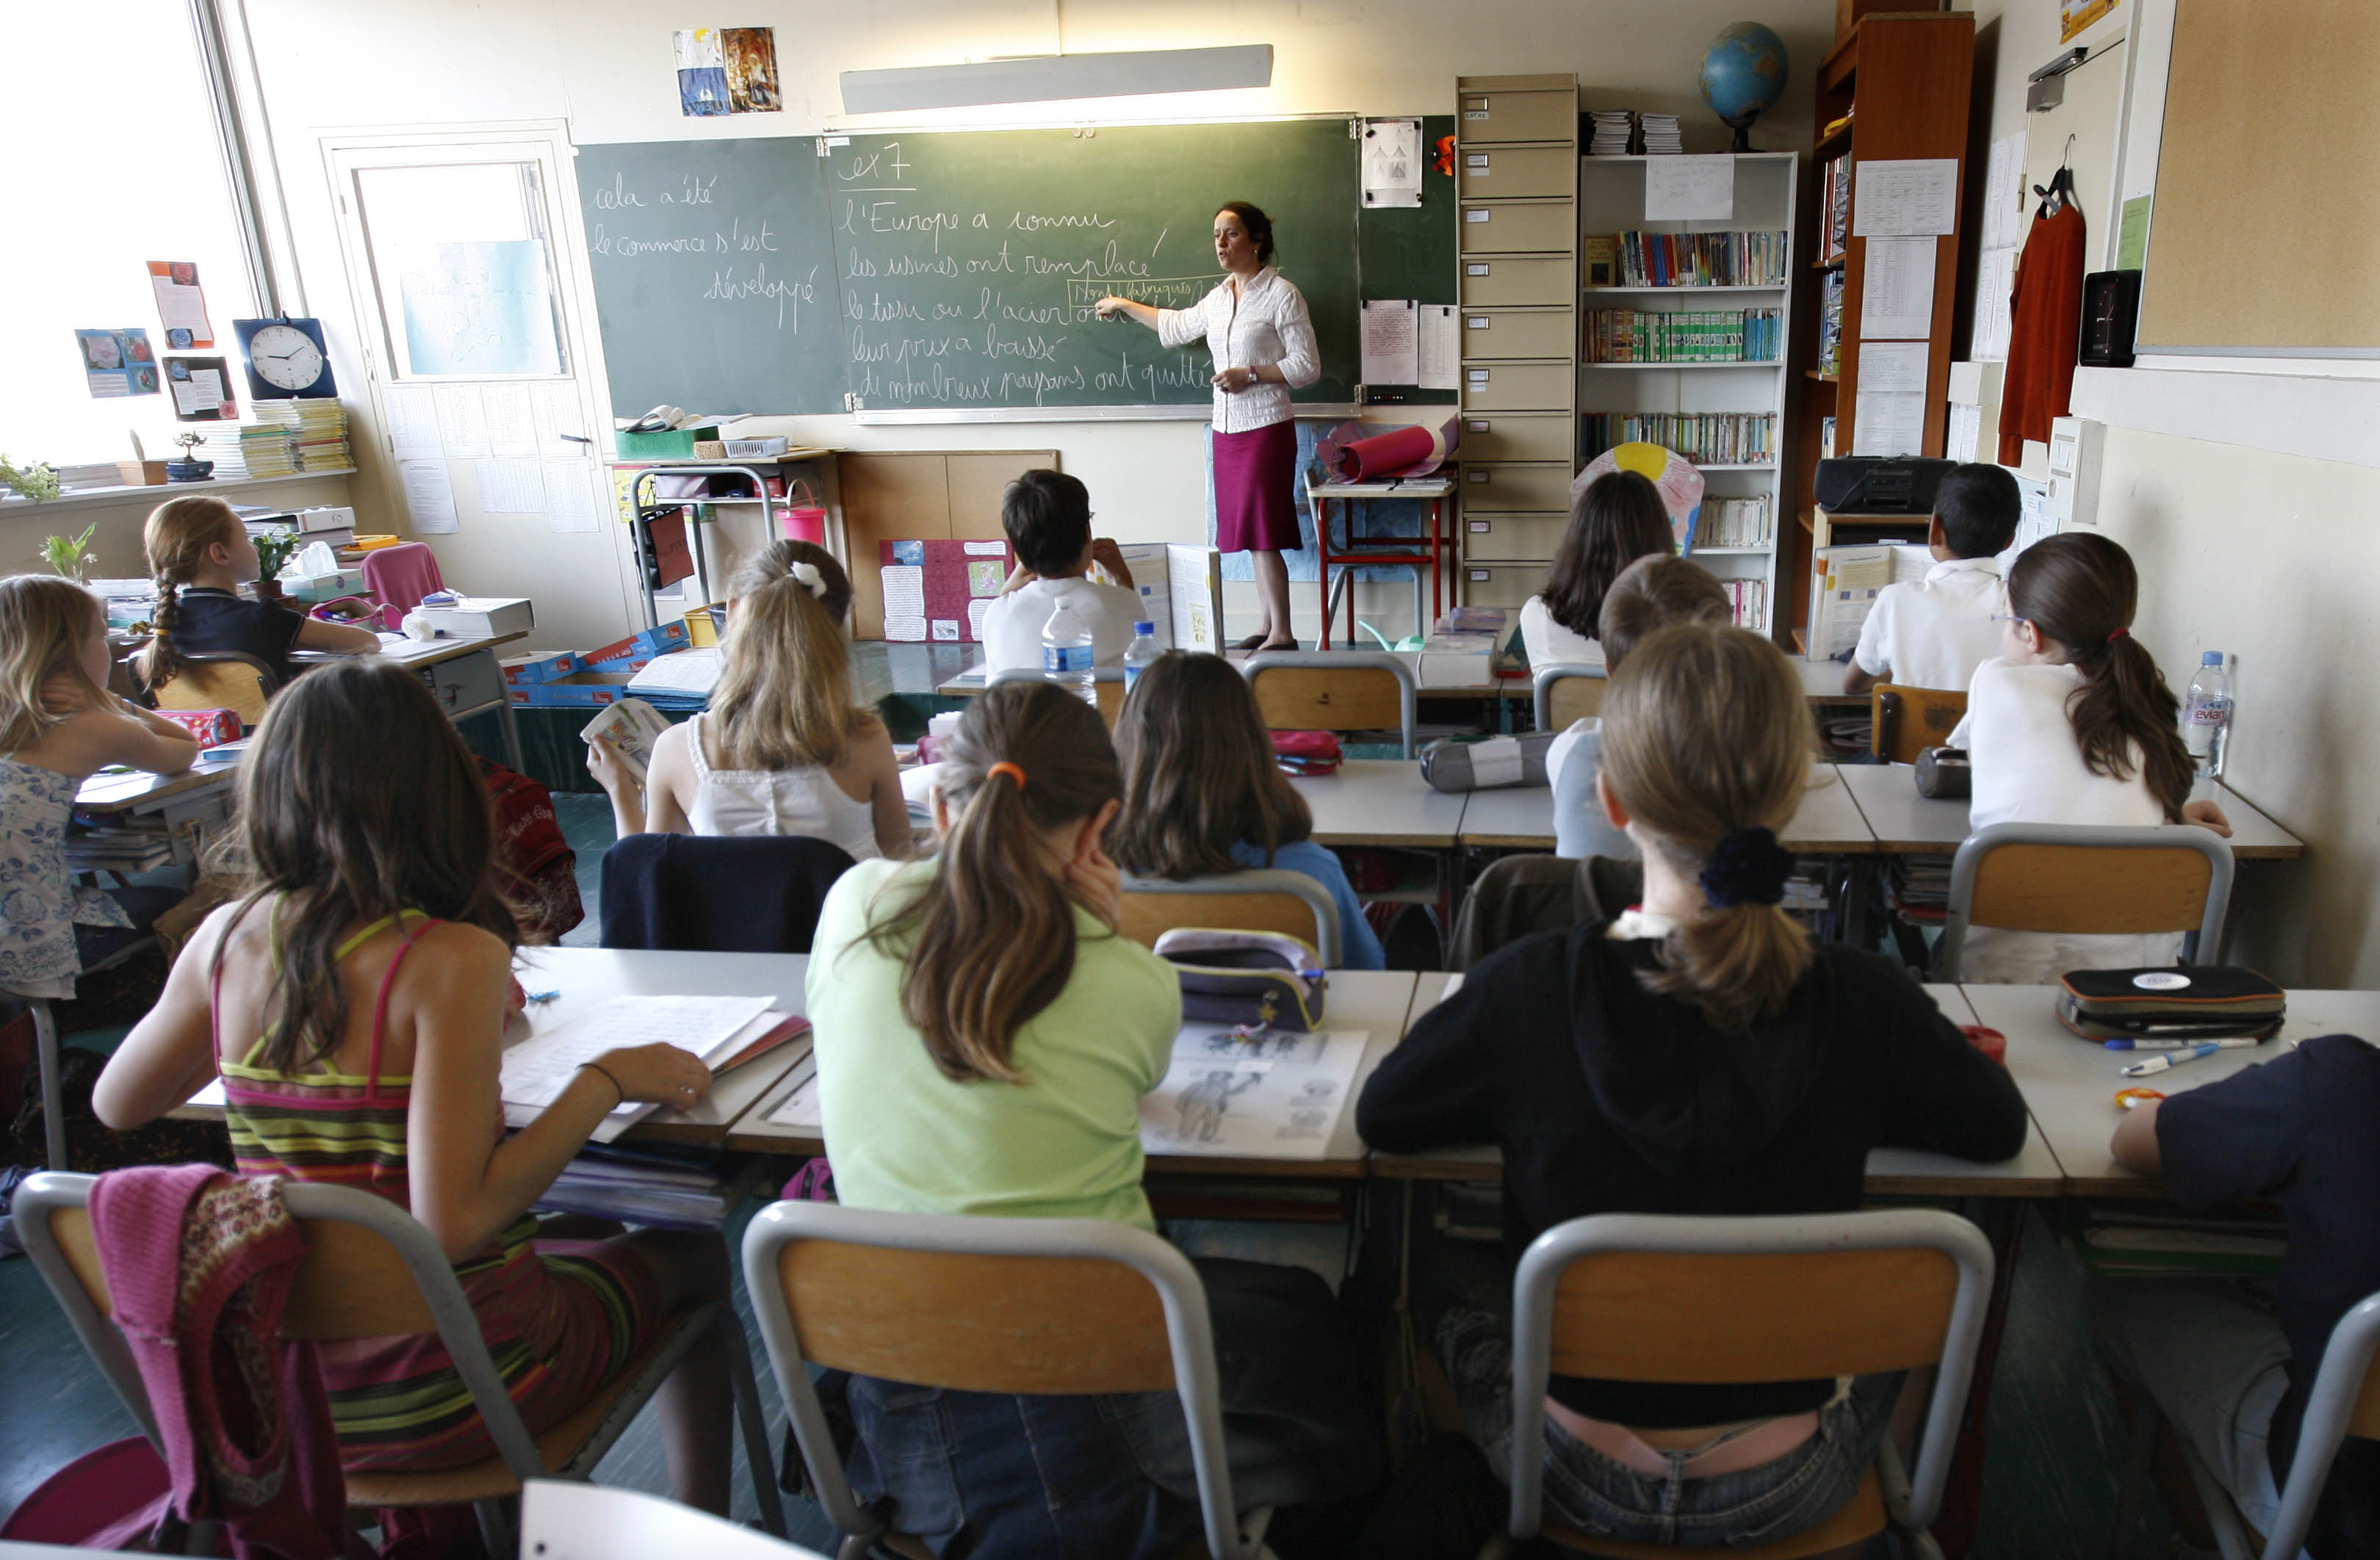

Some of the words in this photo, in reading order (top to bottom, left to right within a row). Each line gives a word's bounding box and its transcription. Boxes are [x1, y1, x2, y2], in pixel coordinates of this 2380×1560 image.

[837, 153, 880, 181] ex
[884, 142, 911, 181] 7
[589, 171, 648, 209] cela
[660, 191, 674, 205] a
[680, 174, 718, 205] été
[590, 223, 611, 256] le
[617, 236, 706, 257] commerce
[715, 217, 779, 253] s'est
[838, 199, 959, 254] l'Europe
[972, 212, 991, 230] a
[1007, 211, 1117, 231] connu
[846, 246, 876, 280] les
[883, 255, 959, 278] usines
[966, 239, 1015, 274] ont
[1025, 227, 1168, 303] remplacé
[703, 261, 819, 335] développé
[845, 289, 864, 320] le
[870, 292, 926, 323] tissu
[932, 303, 964, 321] ou
[973, 286, 1070, 325] l'acier
[852, 325, 891, 364] leur
[894, 336, 951, 394] prix
[955, 337, 973, 352] a
[981, 322, 1067, 363] baissé
[859, 365, 882, 397] de
[889, 362, 992, 403] nombreux
[998, 364, 1086, 407] paysans
[1095, 351, 1136, 391] ont
[1141, 353, 1213, 402] quitté
[2196, 709, 2225, 720] evian
